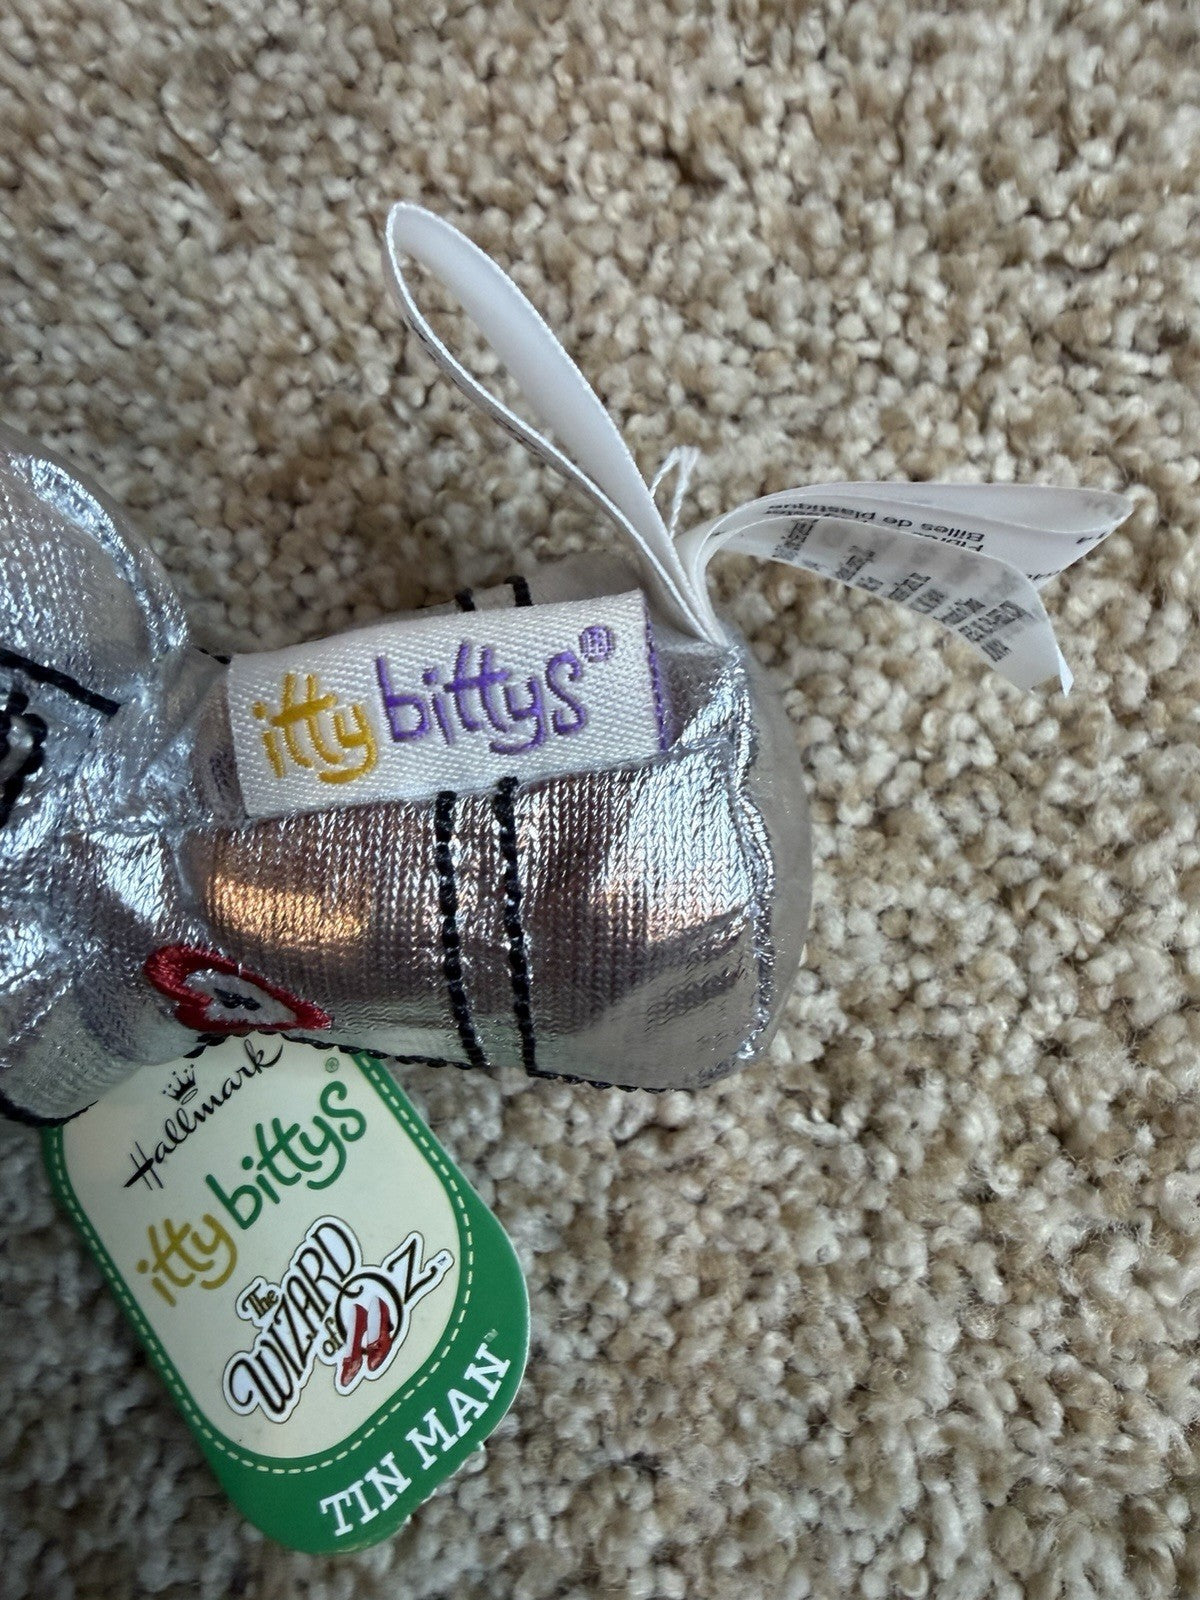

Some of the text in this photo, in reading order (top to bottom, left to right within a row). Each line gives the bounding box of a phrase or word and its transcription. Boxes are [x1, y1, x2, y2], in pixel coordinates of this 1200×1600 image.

[882, 515, 913, 528] de
[920, 522, 985, 543] Billes
[252, 673, 379, 784] itty
[123, 1039, 284, 1190] Hallmark
[136, 1213, 238, 1307] itty
[241, 1283, 279, 1319] The
[229, 1222, 364, 1414] WIZARD
[322, 1316, 344, 1356] of
[319, 1452, 412, 1537] TIN
